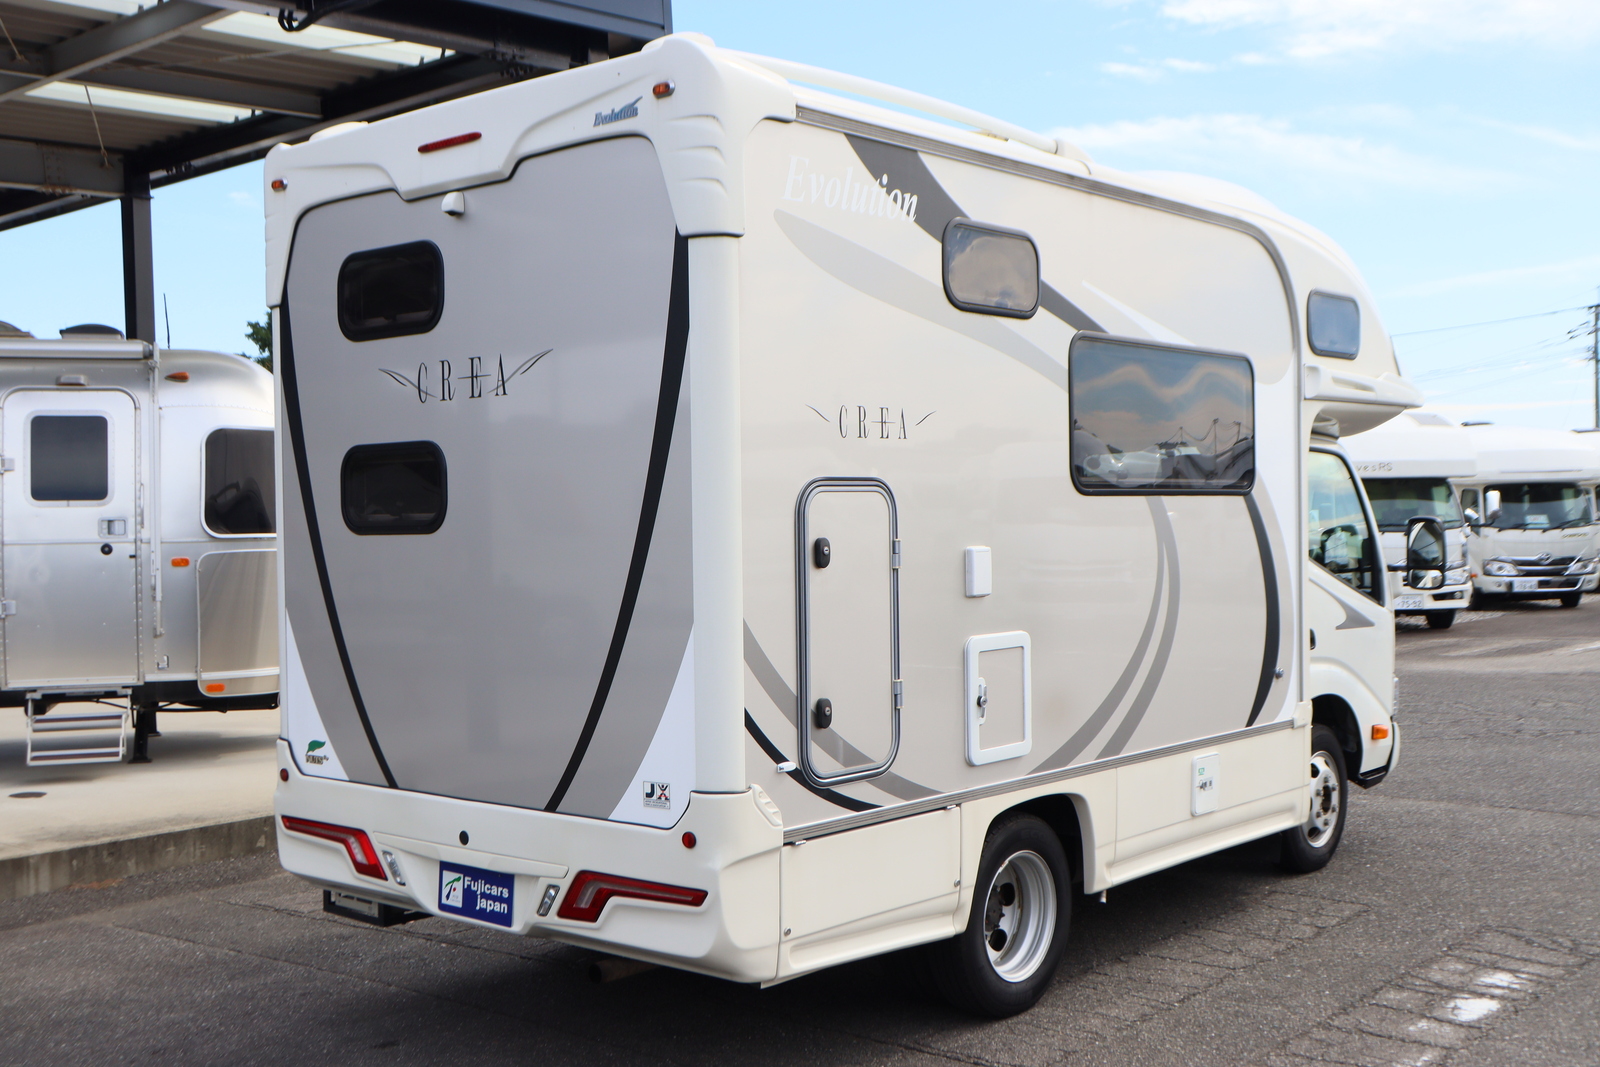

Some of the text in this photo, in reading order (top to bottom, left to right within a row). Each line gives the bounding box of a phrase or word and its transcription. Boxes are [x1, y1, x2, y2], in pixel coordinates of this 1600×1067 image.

[783, 153, 918, 223] Evolution
[417, 353, 508, 404] CREA
[838, 404, 908, 440] CREA
[464, 876, 509, 899] Fujicars
[475, 894, 508, 914] japan
